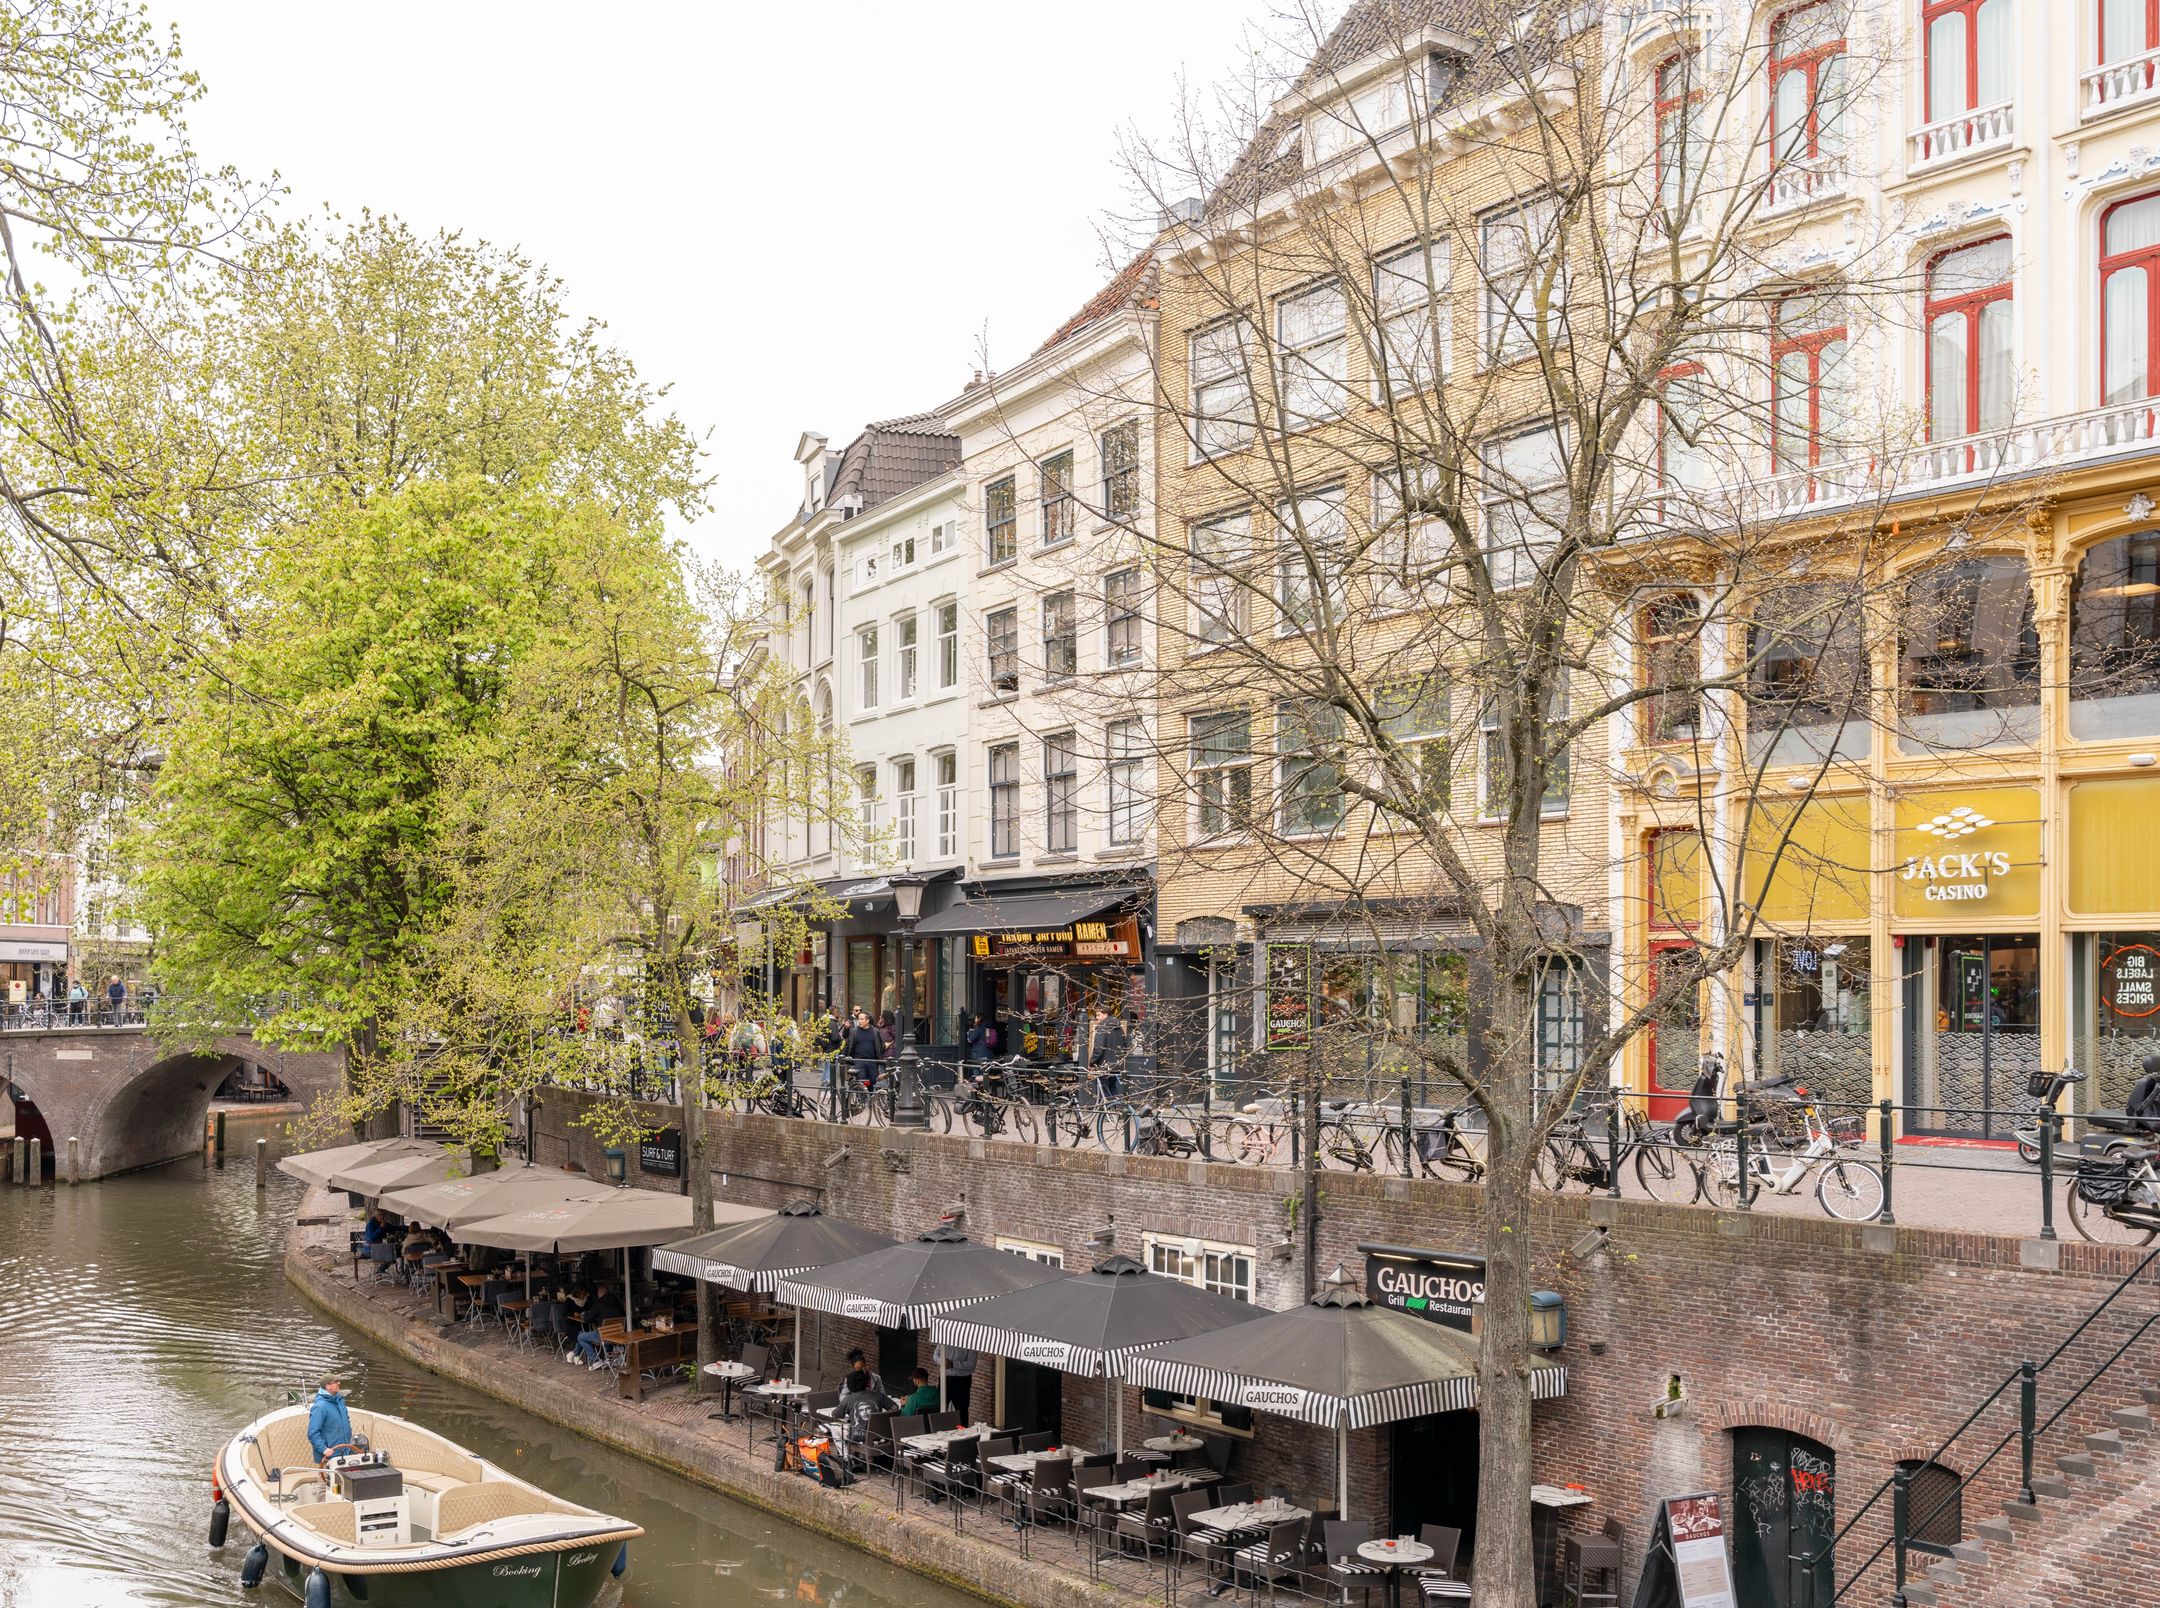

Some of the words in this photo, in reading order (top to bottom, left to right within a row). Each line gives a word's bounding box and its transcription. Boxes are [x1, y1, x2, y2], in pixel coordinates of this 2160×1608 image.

[1902, 852, 2011, 880] JACK'S
[1925, 884, 1988, 900] CASINO
[1075, 922, 1107, 941] RAMEN
[1269, 1019, 1306, 1028] GAUCHOS
[706, 1268, 733, 1278] GAUCHOS
[1377, 1267, 1485, 1302] GAUCHOS
[845, 1303, 877, 1314] GAUCHOS
[1387, 1294, 1405, 1307] Grill
[1429, 1300, 1473, 1316] Restauran
[1022, 1345, 1065, 1358] GAUCHOS
[1245, 1390, 1299, 1405] GAUCHOS
[1685, 1531, 1711, 1540] GAUCHOS
[492, 1564, 543, 1579] Booking
